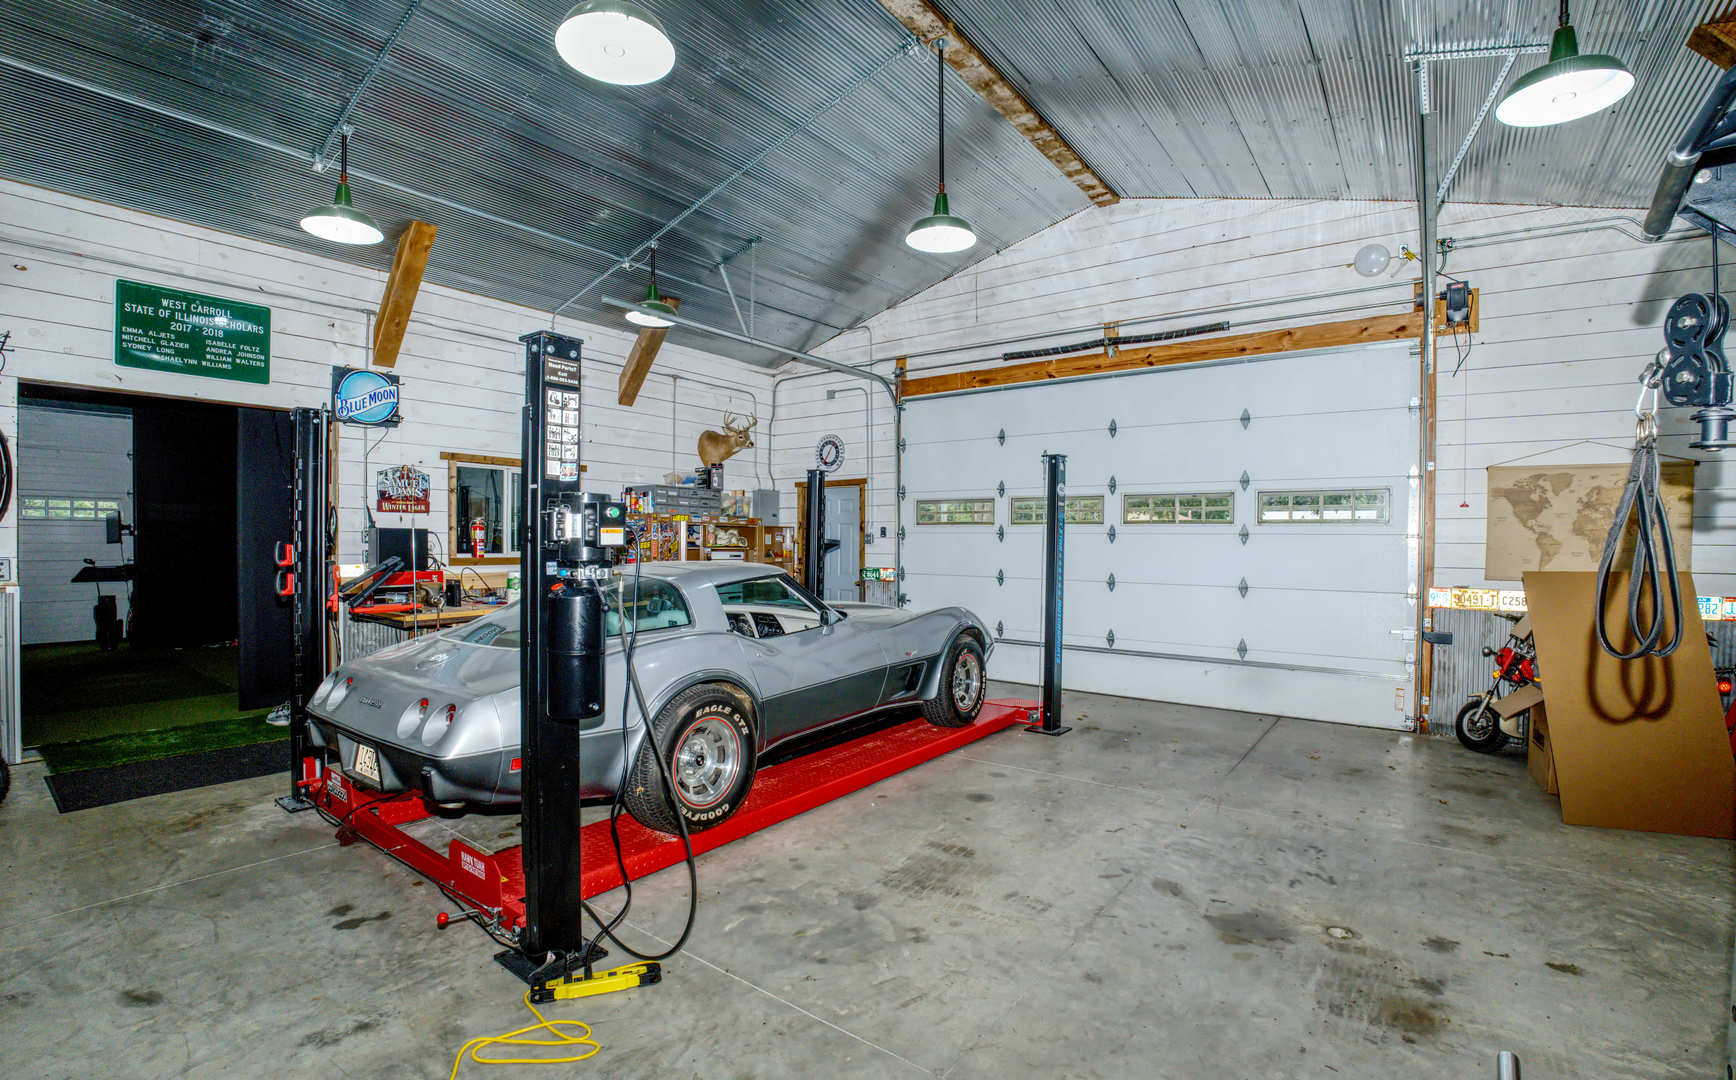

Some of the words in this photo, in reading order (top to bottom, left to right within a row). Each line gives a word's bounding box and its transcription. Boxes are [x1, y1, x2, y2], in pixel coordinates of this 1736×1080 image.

[161, 298, 187, 311] WEST
[190, 303, 232, 319] CARROLL
[124, 302, 155, 316] STATE
[158, 308, 171, 318] OF
[175, 311, 214, 326] ILLINOIS
[214, 316, 264, 335] CHOLARS
[122, 326, 143, 335] EMMA
[170, 321, 192, 333] 2017
[202, 327, 224, 338] 2018
[122, 334, 155, 344] MITCHELL
[160, 339, 190, 349] GLAZIER
[122, 341, 152, 351] SYDNEY
[156, 346, 175, 354] LONG
[205, 339, 237, 349] ISABELLE
[239, 344, 260, 353] FOLTZ
[205, 353, 232, 362] WILLIAM
[235, 358, 265, 368] WALTERS
[206, 346, 233, 355] ANDREA
[236, 351, 265, 361] JOHNSON
[201, 360, 232, 370] WILLIAMS
[337, 397, 367, 417] BLUE
[368, 388, 396, 406] MOON
[695, 704, 733, 718] EAGLE
[680, 803, 730, 821] GOODYE
